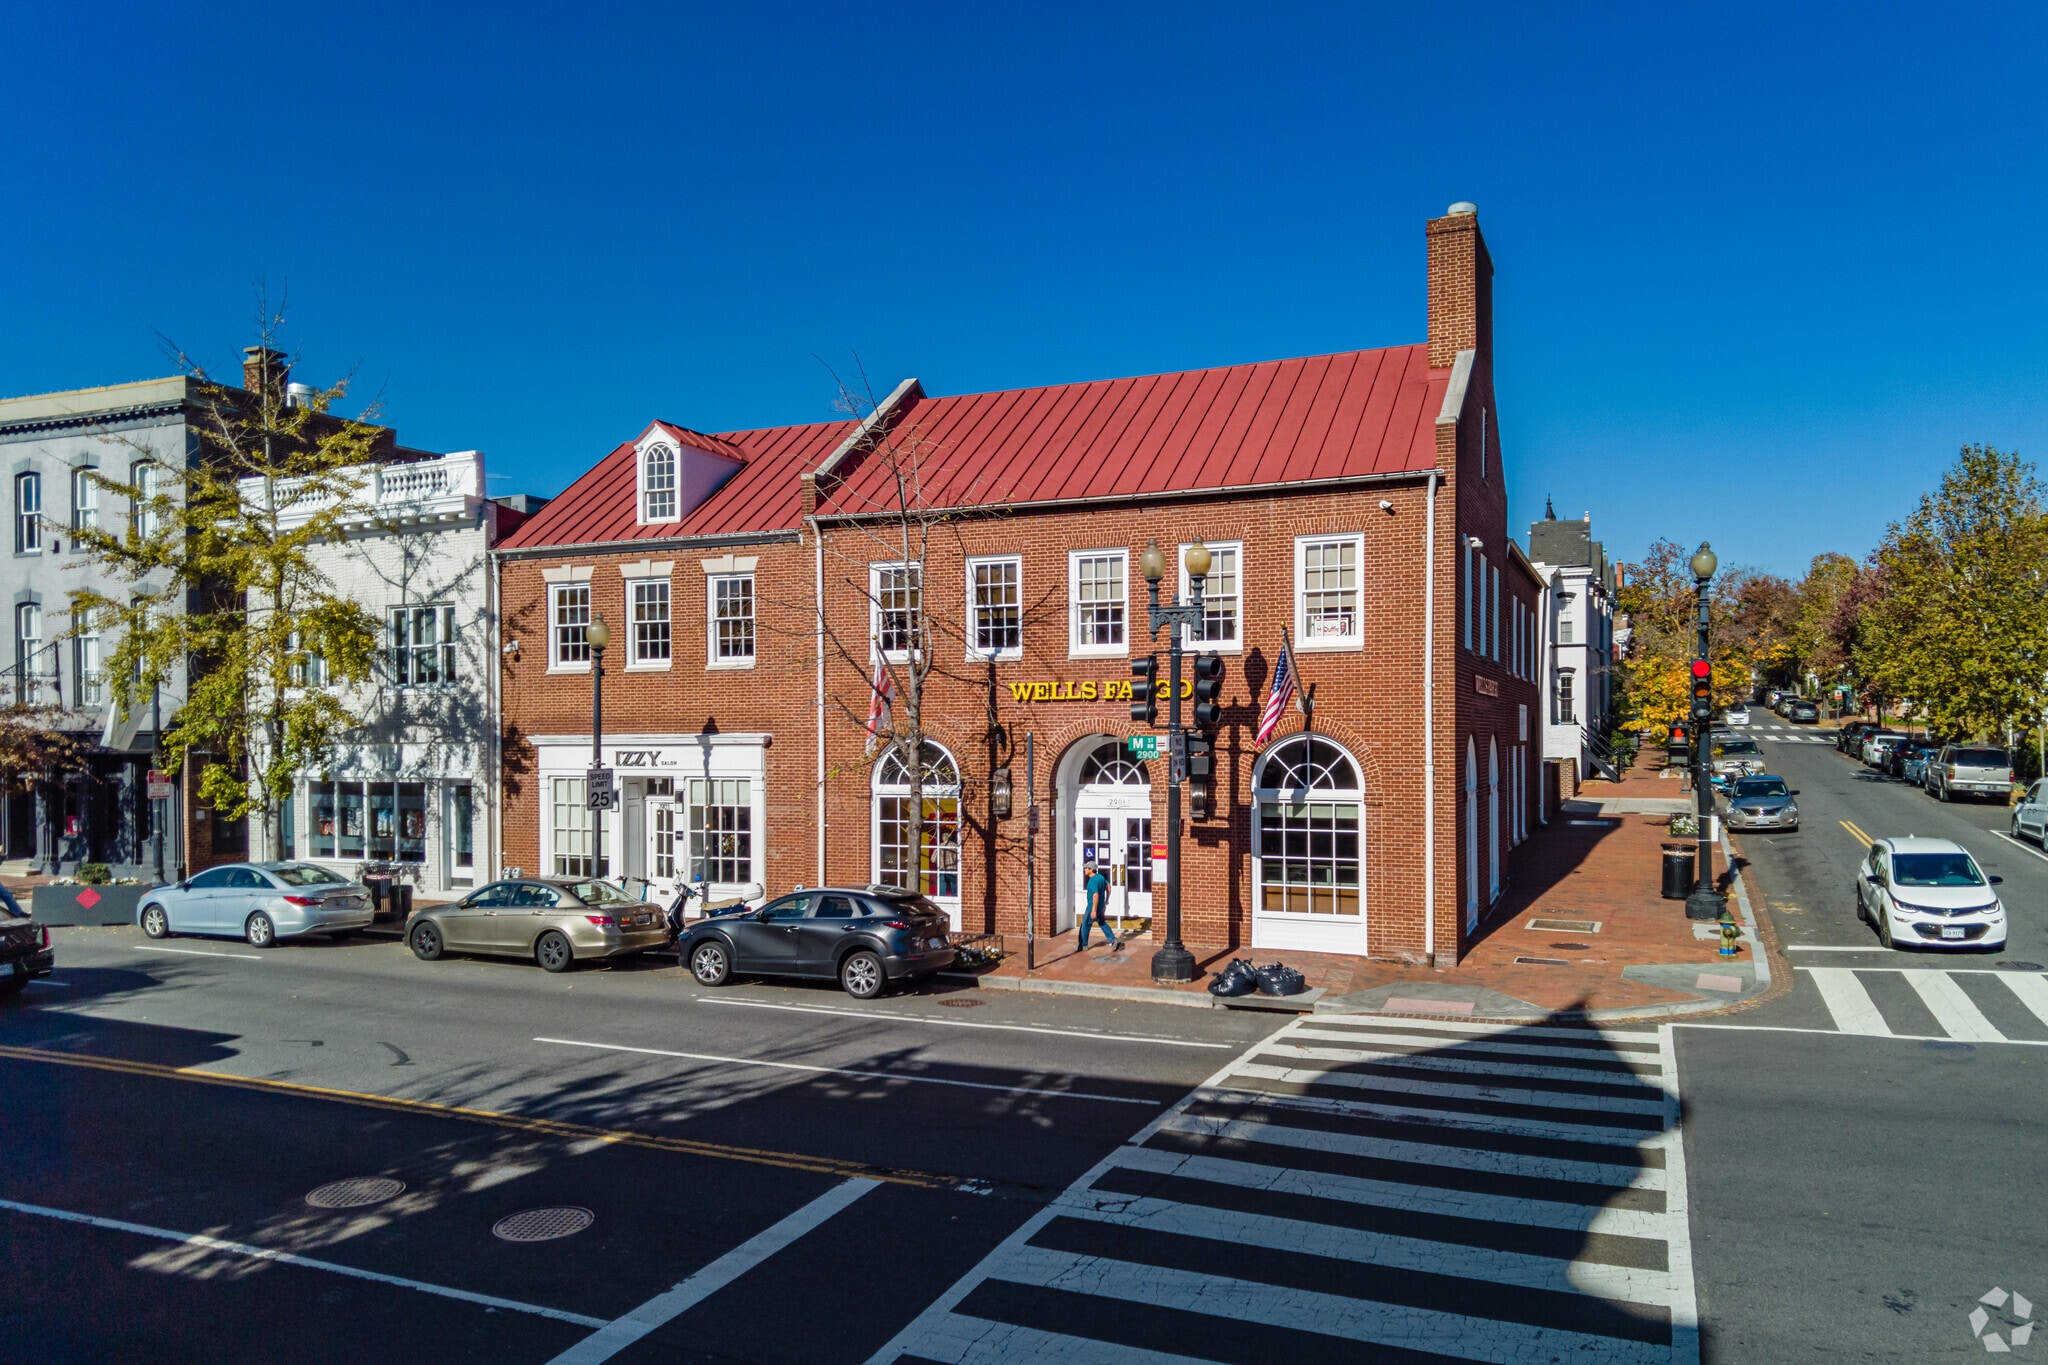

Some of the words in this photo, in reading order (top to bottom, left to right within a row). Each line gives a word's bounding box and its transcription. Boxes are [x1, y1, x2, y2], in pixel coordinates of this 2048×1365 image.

[1008, 681, 1098, 700] WELLS
[1103, 679, 1193, 699] FAGO
[1133, 738, 1143, 748] M
[615, 751, 661, 766] IZZY
[1137, 751, 1159, 759] 2900
[592, 780, 608, 788] LIMIT
[591, 791, 609, 807] 25
